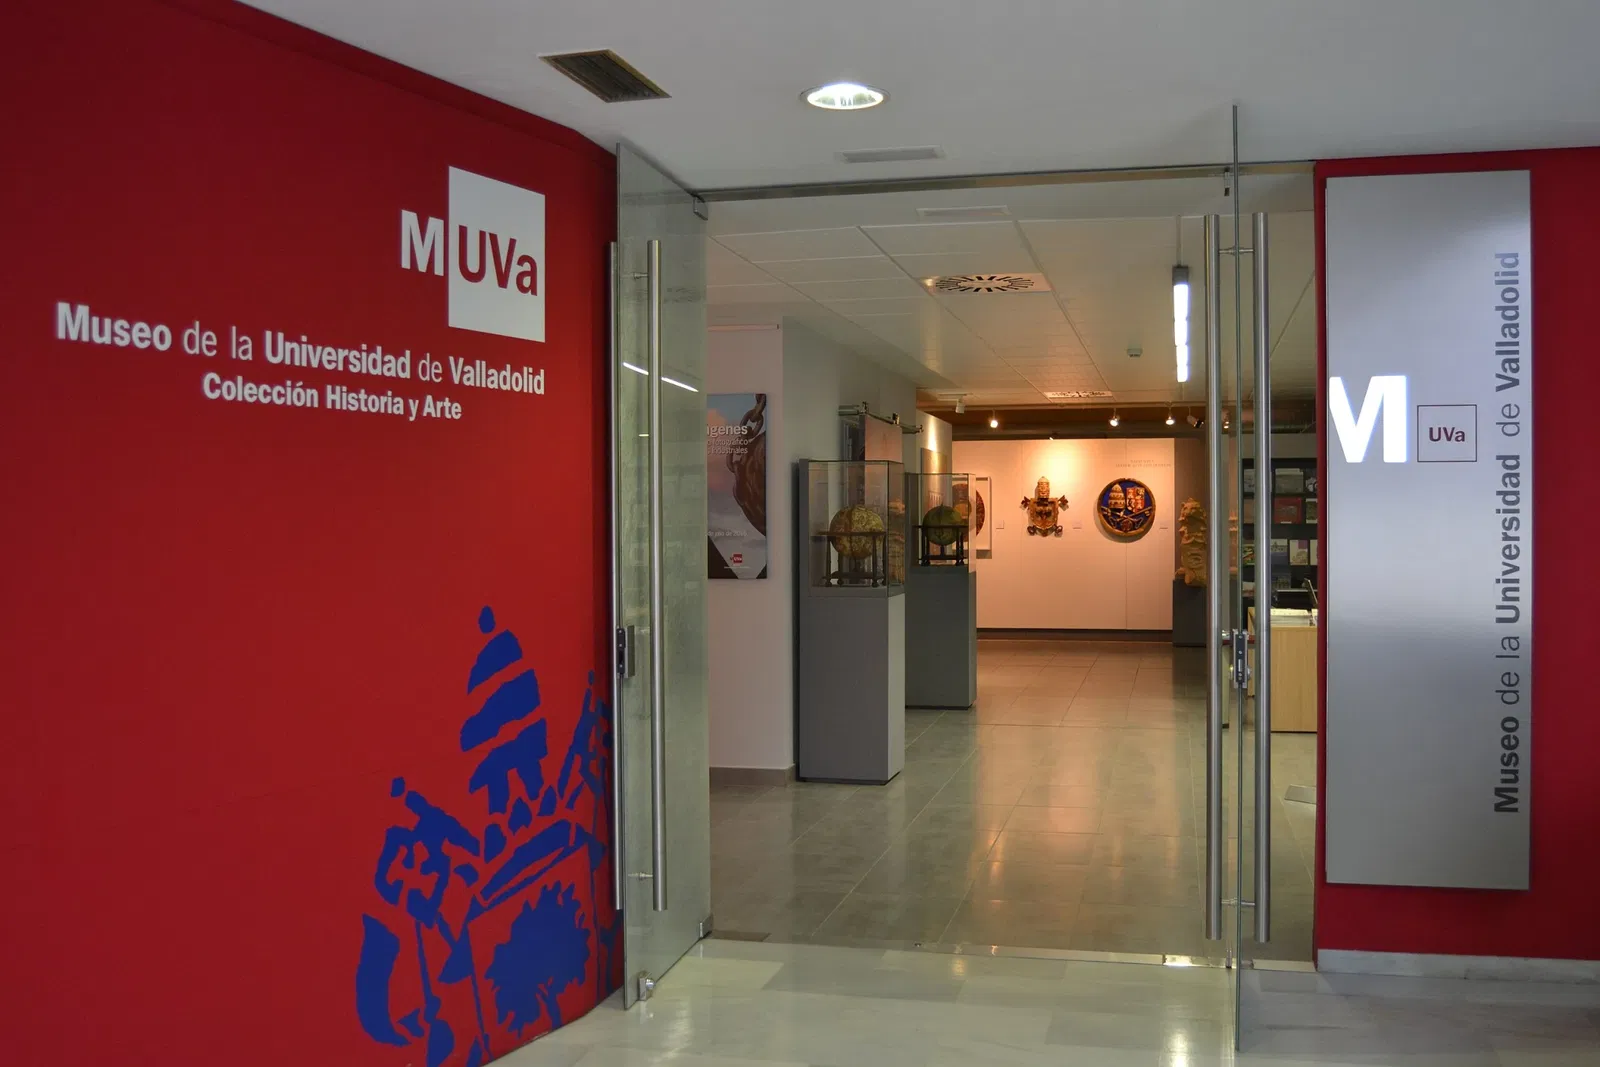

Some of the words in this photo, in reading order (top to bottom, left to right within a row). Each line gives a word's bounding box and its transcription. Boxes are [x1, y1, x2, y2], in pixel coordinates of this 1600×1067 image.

[1494, 252, 1520, 393] Valladolid
[56, 301, 173, 352] Museo
[183, 320, 218, 357] de
[231, 326, 253, 361] la
[264, 330, 411, 379] Universidad
[418, 352, 443, 383] de
[448, 356, 545, 396] Valladolid
[202, 371, 318, 408] Colección
[325, 384, 404, 415] Historia
[408, 398, 420, 422] y
[422, 395, 462, 420] Arte
[1495, 403, 1520, 437] de
[1428, 426, 1467, 443] UVa
[1494, 454, 1521, 624] Universidad
[1494, 636, 1520, 659] la
[1494, 671, 1520, 706] de
[1493, 716, 1520, 813] Museo
